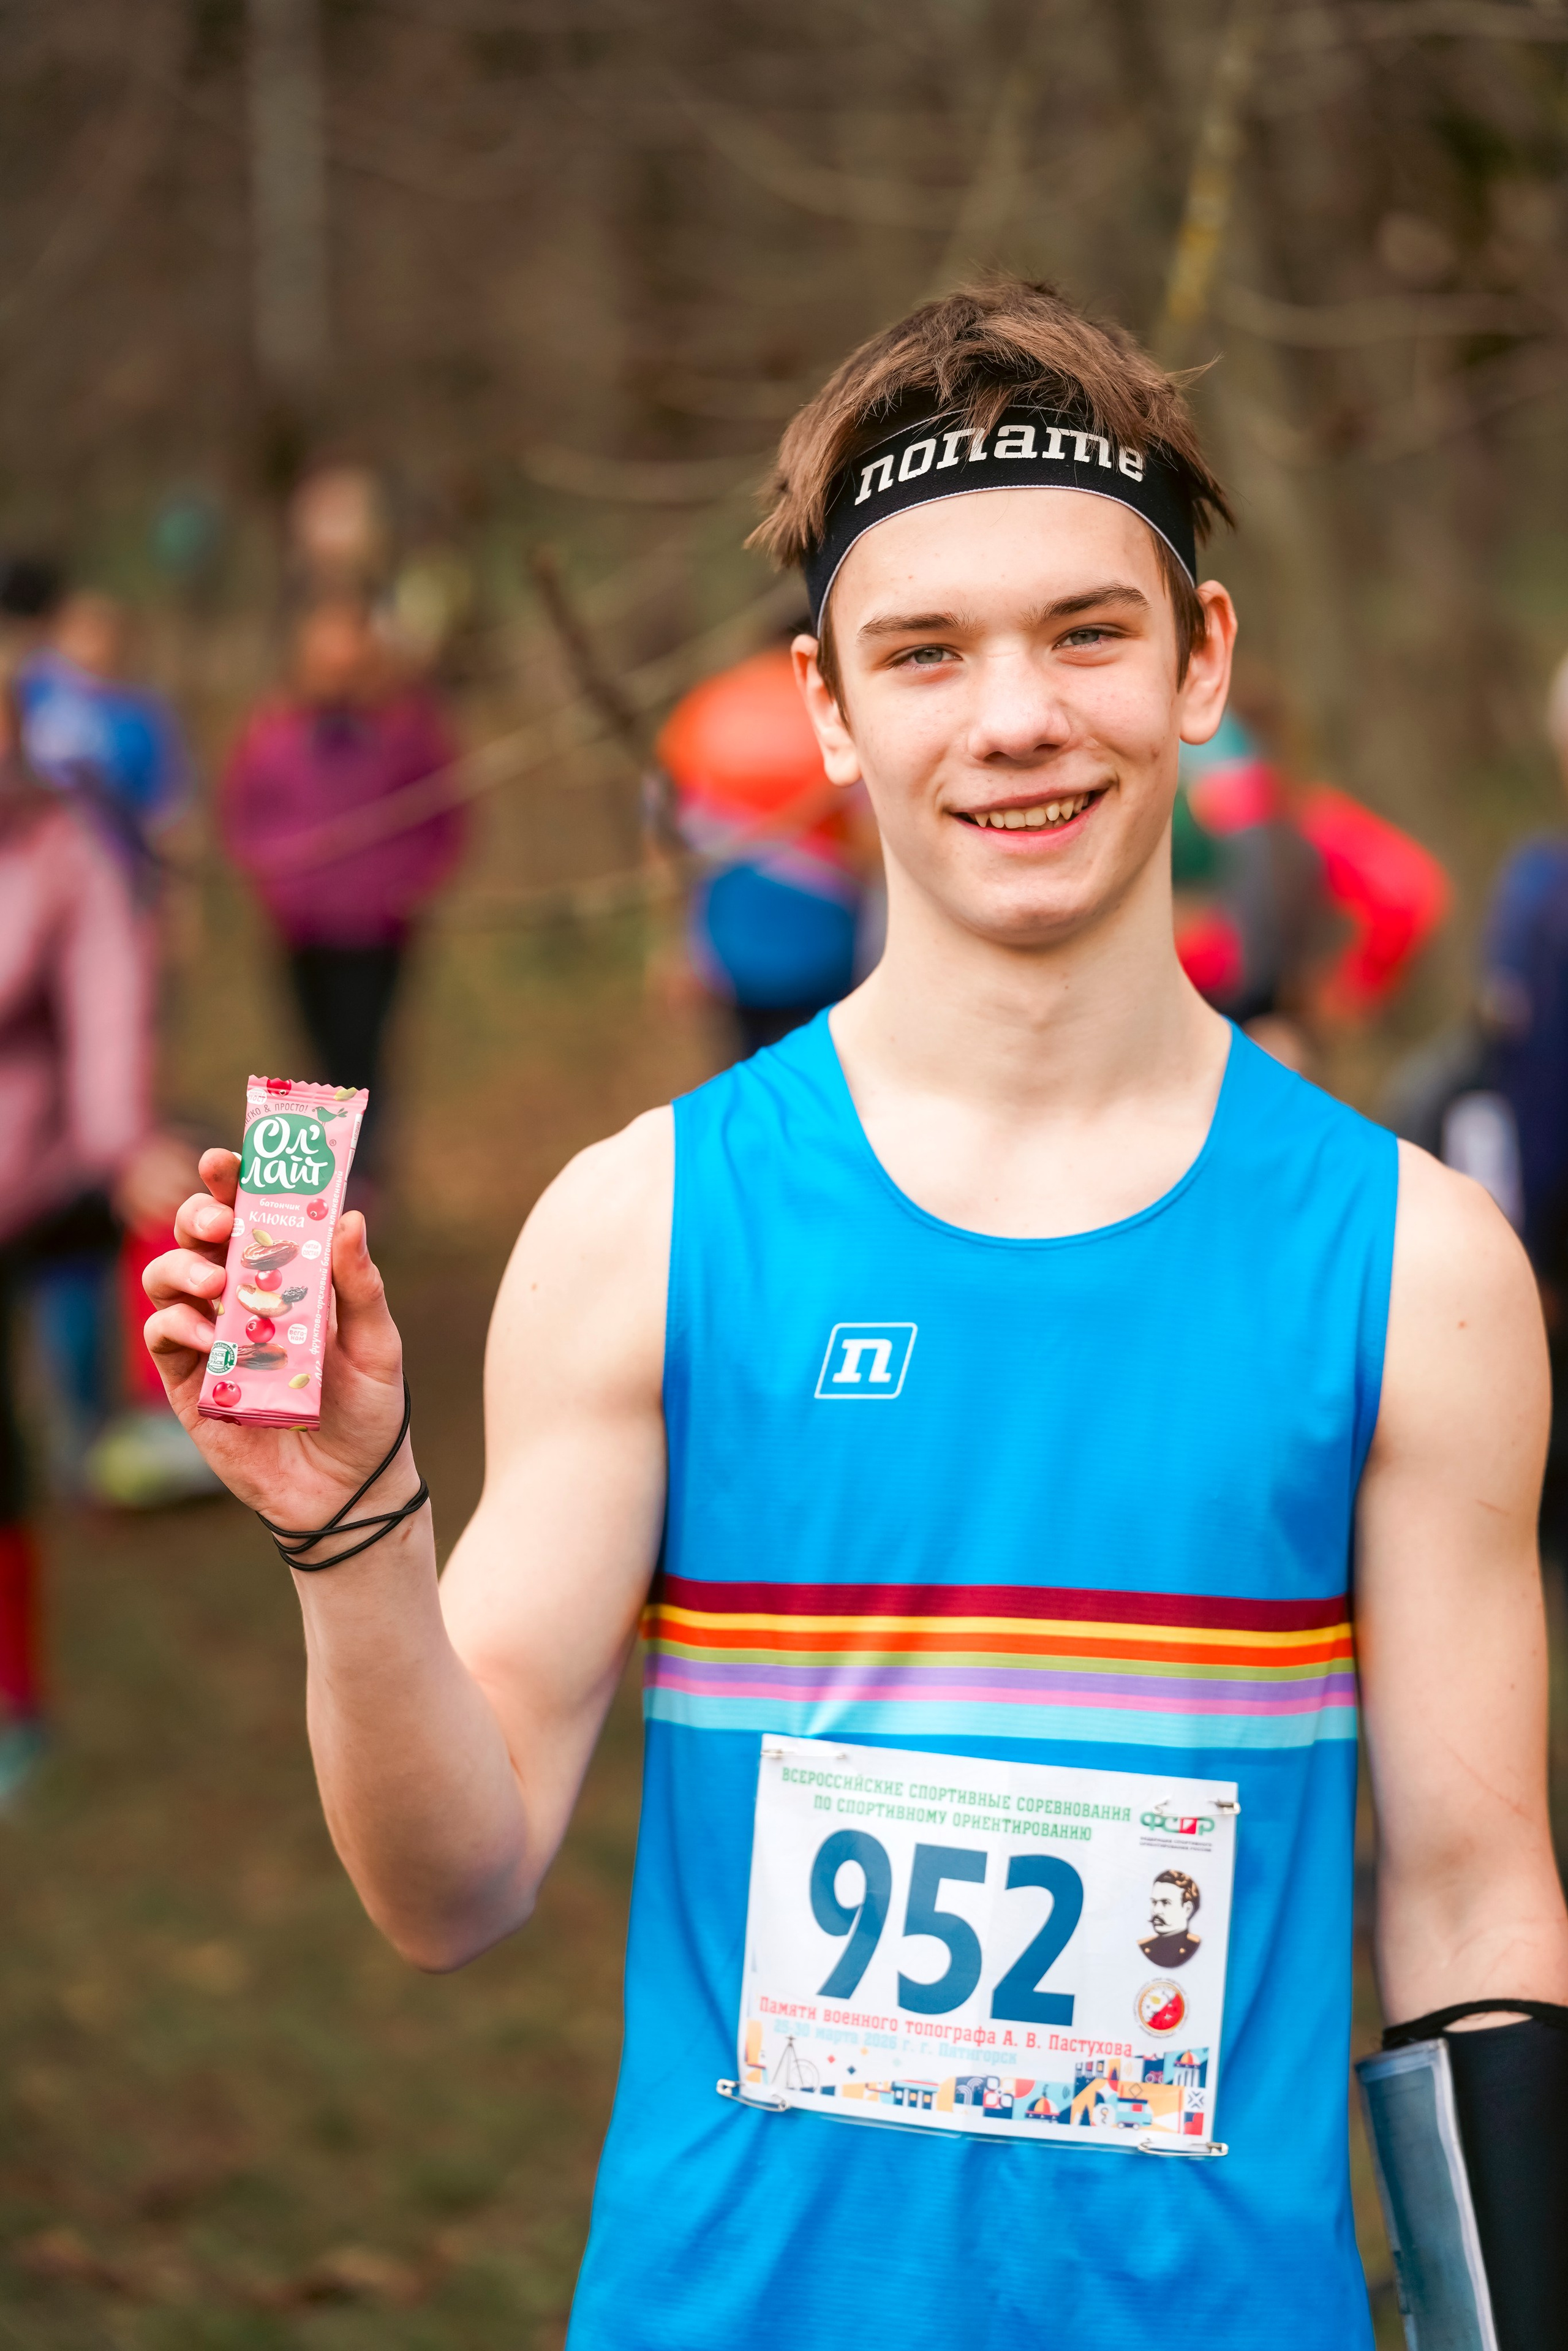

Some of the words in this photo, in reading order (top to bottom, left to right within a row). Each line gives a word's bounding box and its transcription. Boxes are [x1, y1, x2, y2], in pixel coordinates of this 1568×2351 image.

[854, 425, 1144, 505] noname
[275, 1103, 308, 1113] ПРОСТО!
[260, 1198, 301, 1210] батончик
[309, 1268, 328, 1355] фруктово-ореховый
[320, 1226, 334, 1266] батончик
[329, 1171, 343, 1225] клюквенный
[782, 1767, 903, 1796] ВСЕРОССИЙСКИЕ
[909, 1783, 1011, 1809] СПОРТИВНЫЕ
[1017, 1796, 1131, 1822] СОРЕВНОВАНИЯ
[814, 1794, 831, 1810] ПО
[837, 1797, 947, 1825] СПОРТИВНОМУ
[952, 1812, 1092, 1841] ОРИЕНТИРОВАНИЮ
[809, 1828, 1084, 2026] 952
[760, 1996, 816, 2020] Памяти
[823, 2009, 898, 2032] военного
[905, 2020, 996, 2047] топографа
[1003, 2029, 1017, 2047] А.
[1025, 2032, 1041, 2048] В.
[1049, 2034, 1133, 2057] Пастухова
[815, 2027, 859, 2045] марта
[864, 2032, 897, 2050] 2026
[938, 2042, 1017, 2066] Пятигорск
